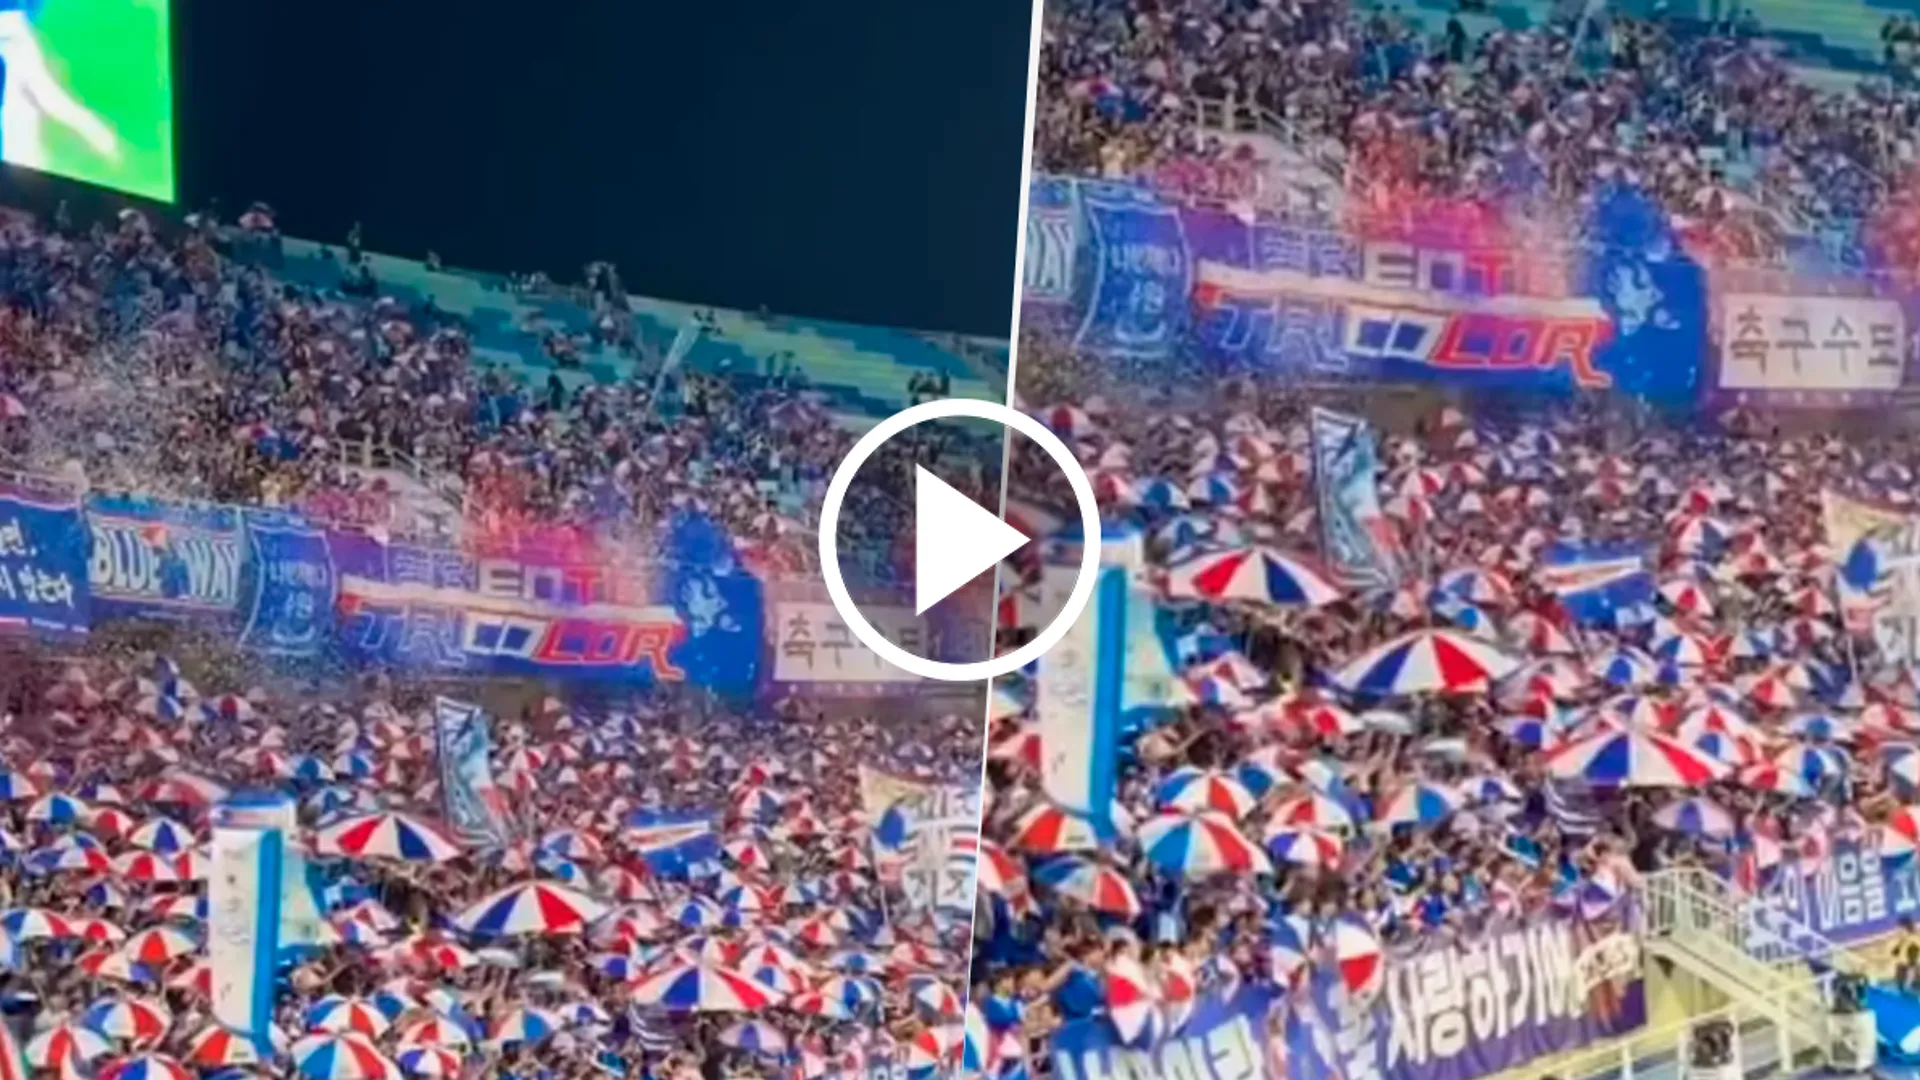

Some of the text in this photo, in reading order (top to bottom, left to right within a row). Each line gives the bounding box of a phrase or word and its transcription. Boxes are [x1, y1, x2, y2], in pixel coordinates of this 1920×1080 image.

[1217, 299, 1613, 389] TRICOLOR
[1730, 305, 1899, 376] 축구수도
[90, 519, 163, 594] BLUE
[176, 537, 240, 603] WAY
[355, 603, 686, 682] TRICOLOR
